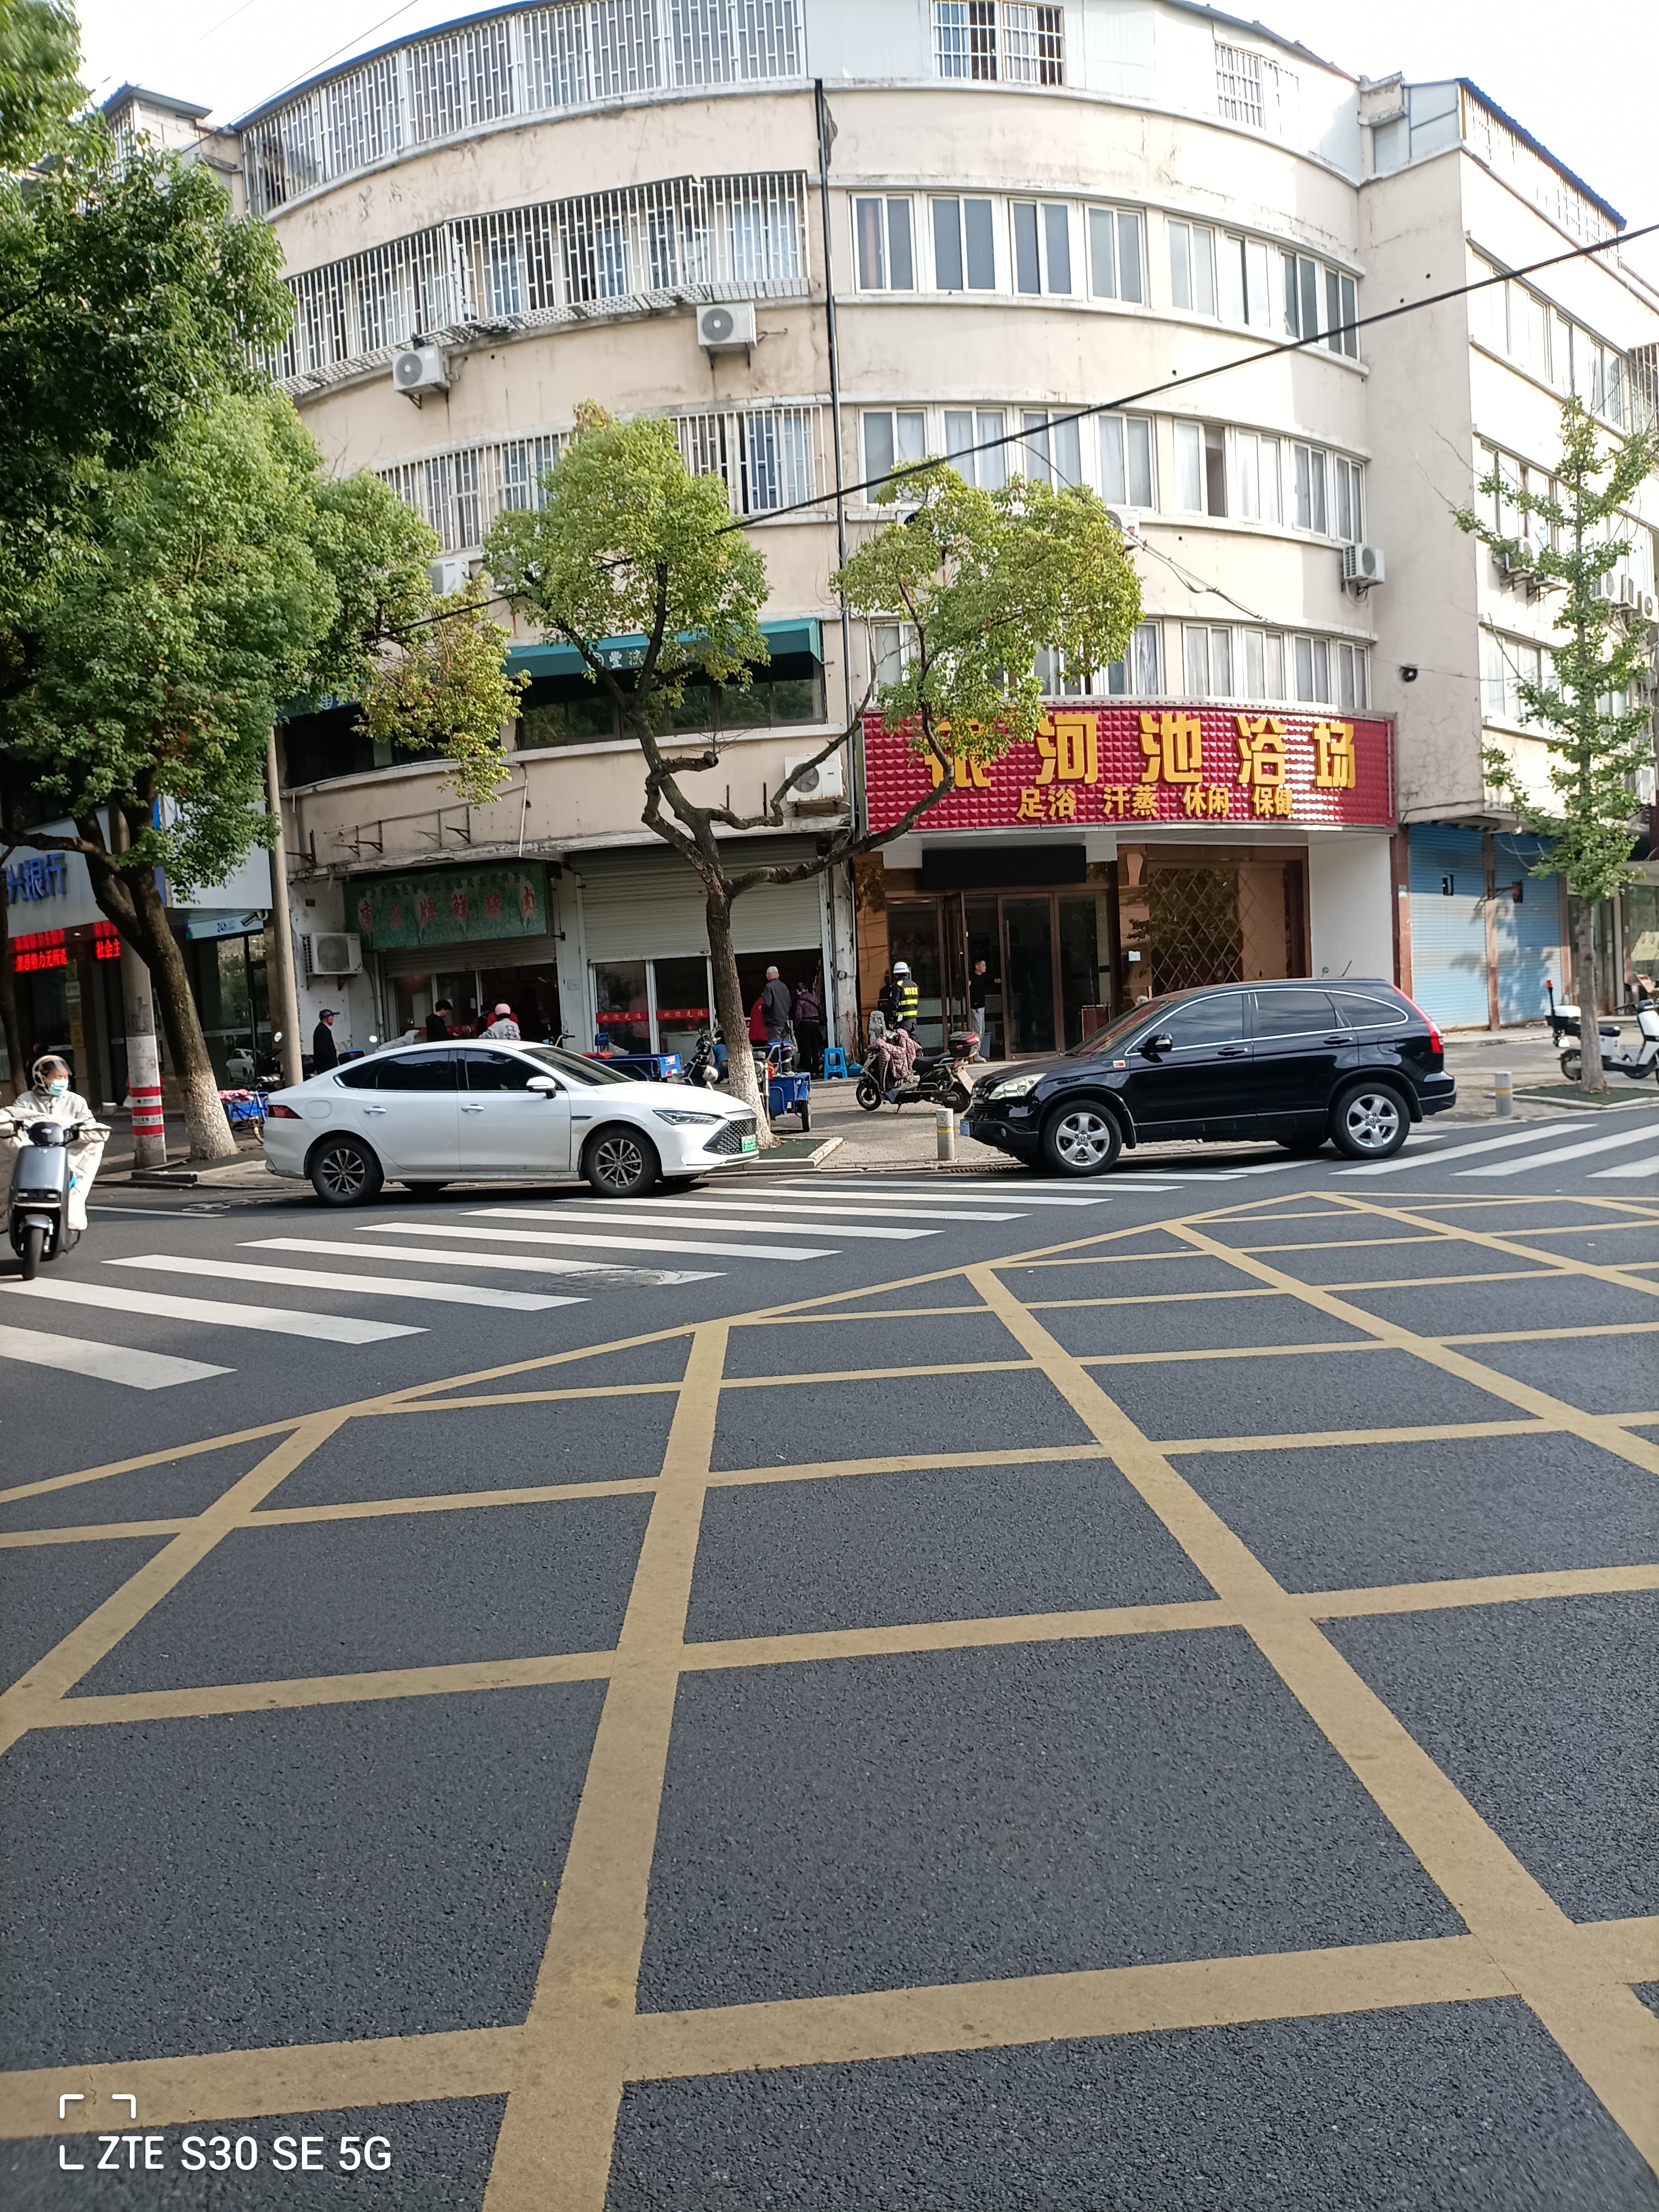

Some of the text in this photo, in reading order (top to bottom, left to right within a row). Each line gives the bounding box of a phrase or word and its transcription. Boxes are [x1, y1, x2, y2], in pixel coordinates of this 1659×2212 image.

[924, 713, 1356, 789] 银河池浴场
[1016, 785, 1294, 817] 足浴 汗蒸 休闲 保健
[96, 938, 120, 958] 社会主
[664, 1010, 704, 1018] 欢迎光临
